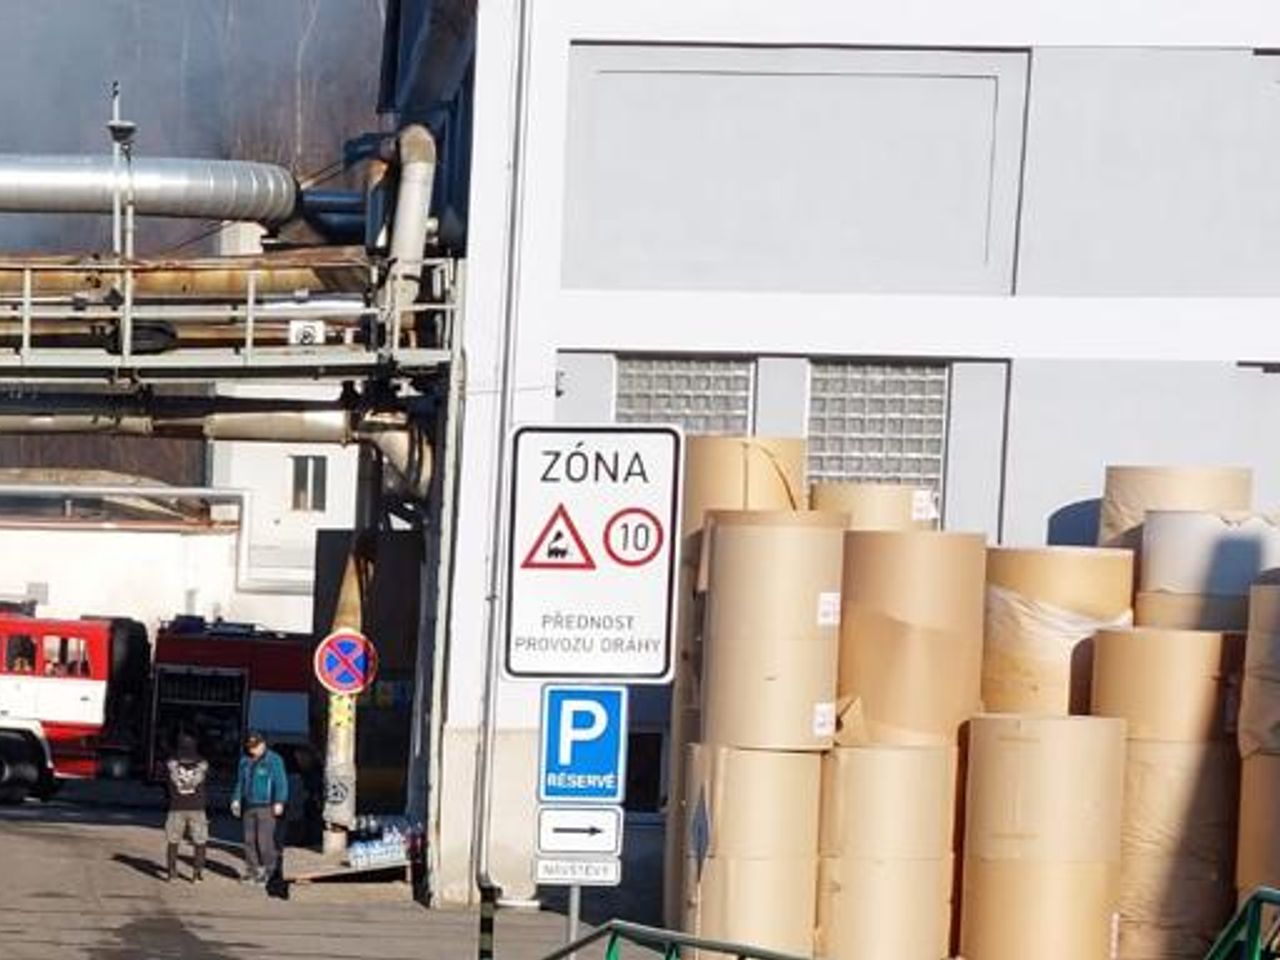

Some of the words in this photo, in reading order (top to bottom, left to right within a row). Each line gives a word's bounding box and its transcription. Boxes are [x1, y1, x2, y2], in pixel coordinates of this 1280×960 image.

[540, 441, 649, 483] ZÓNA
[621, 522, 651, 551] 10
[541, 611, 635, 630] PŘEDNOST
[515, 637, 594, 653] PROVOZU
[600, 635, 662, 654] DRÁHY
[558, 699, 609, 766] P
